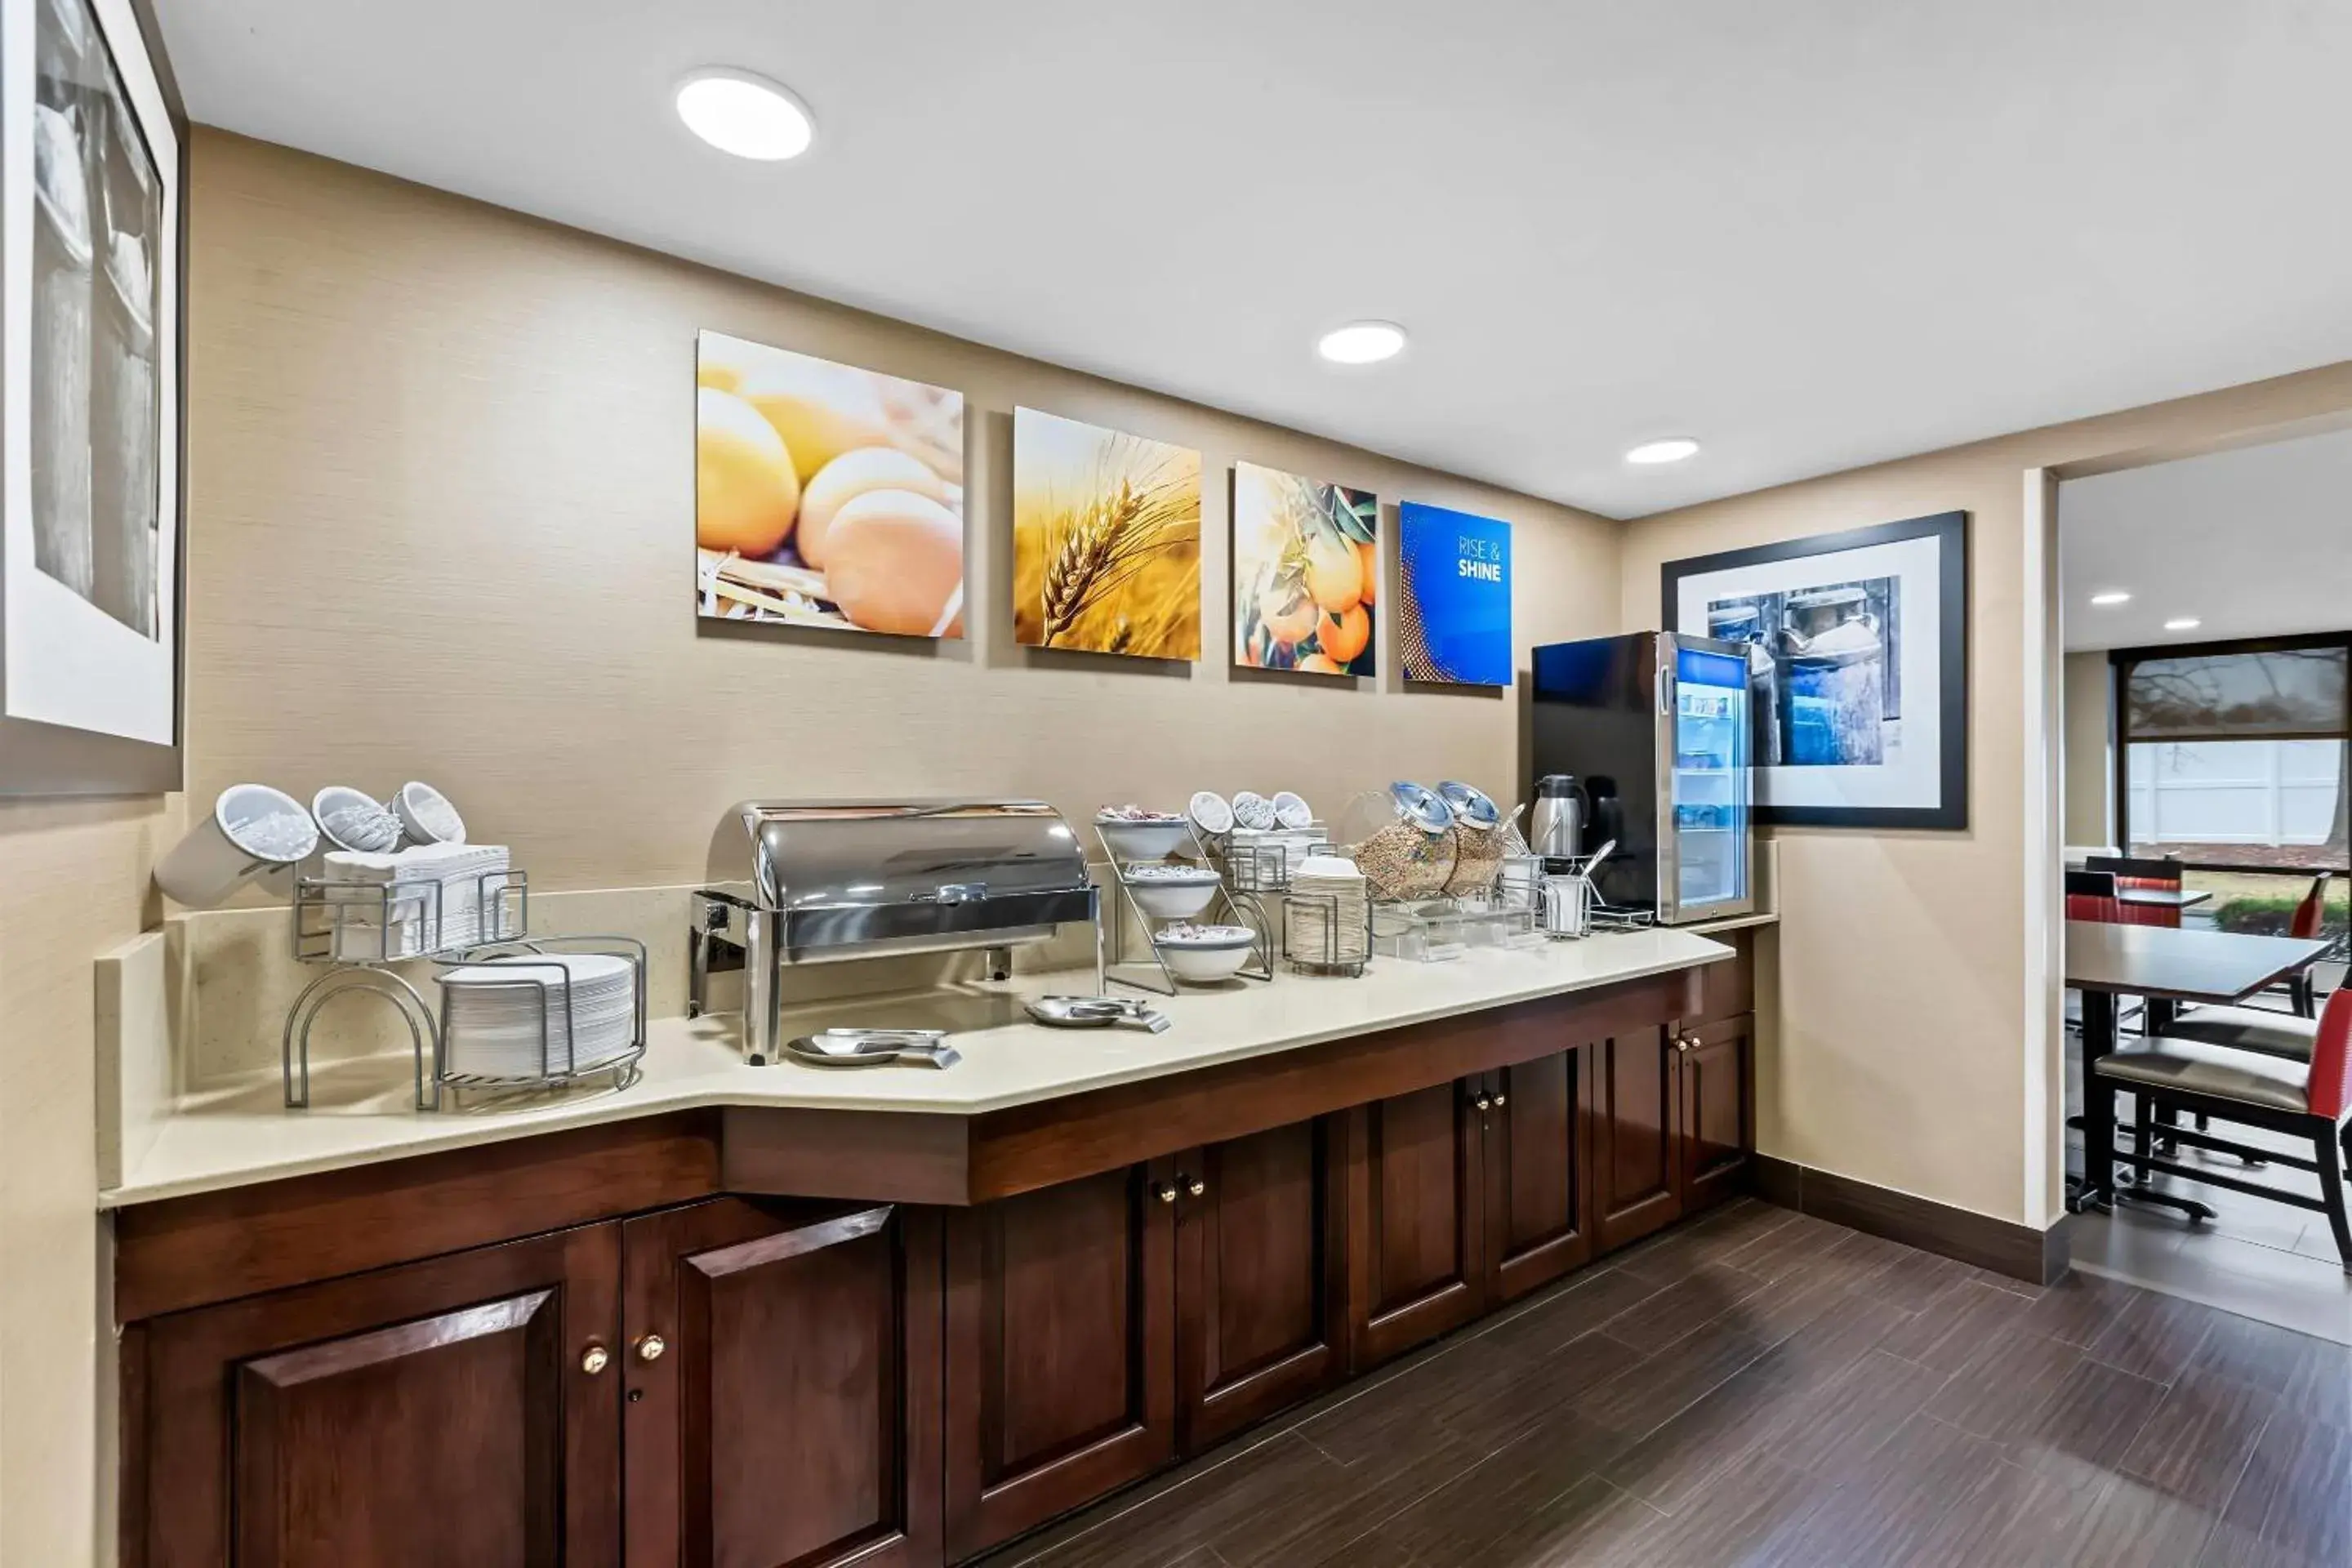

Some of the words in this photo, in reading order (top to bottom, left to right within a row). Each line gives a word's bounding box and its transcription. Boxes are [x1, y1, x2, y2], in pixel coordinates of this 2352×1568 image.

[1459, 536, 1486, 559] RISE
[1490, 542, 1500, 560] &
[1459, 559, 1501, 581] SHINE
